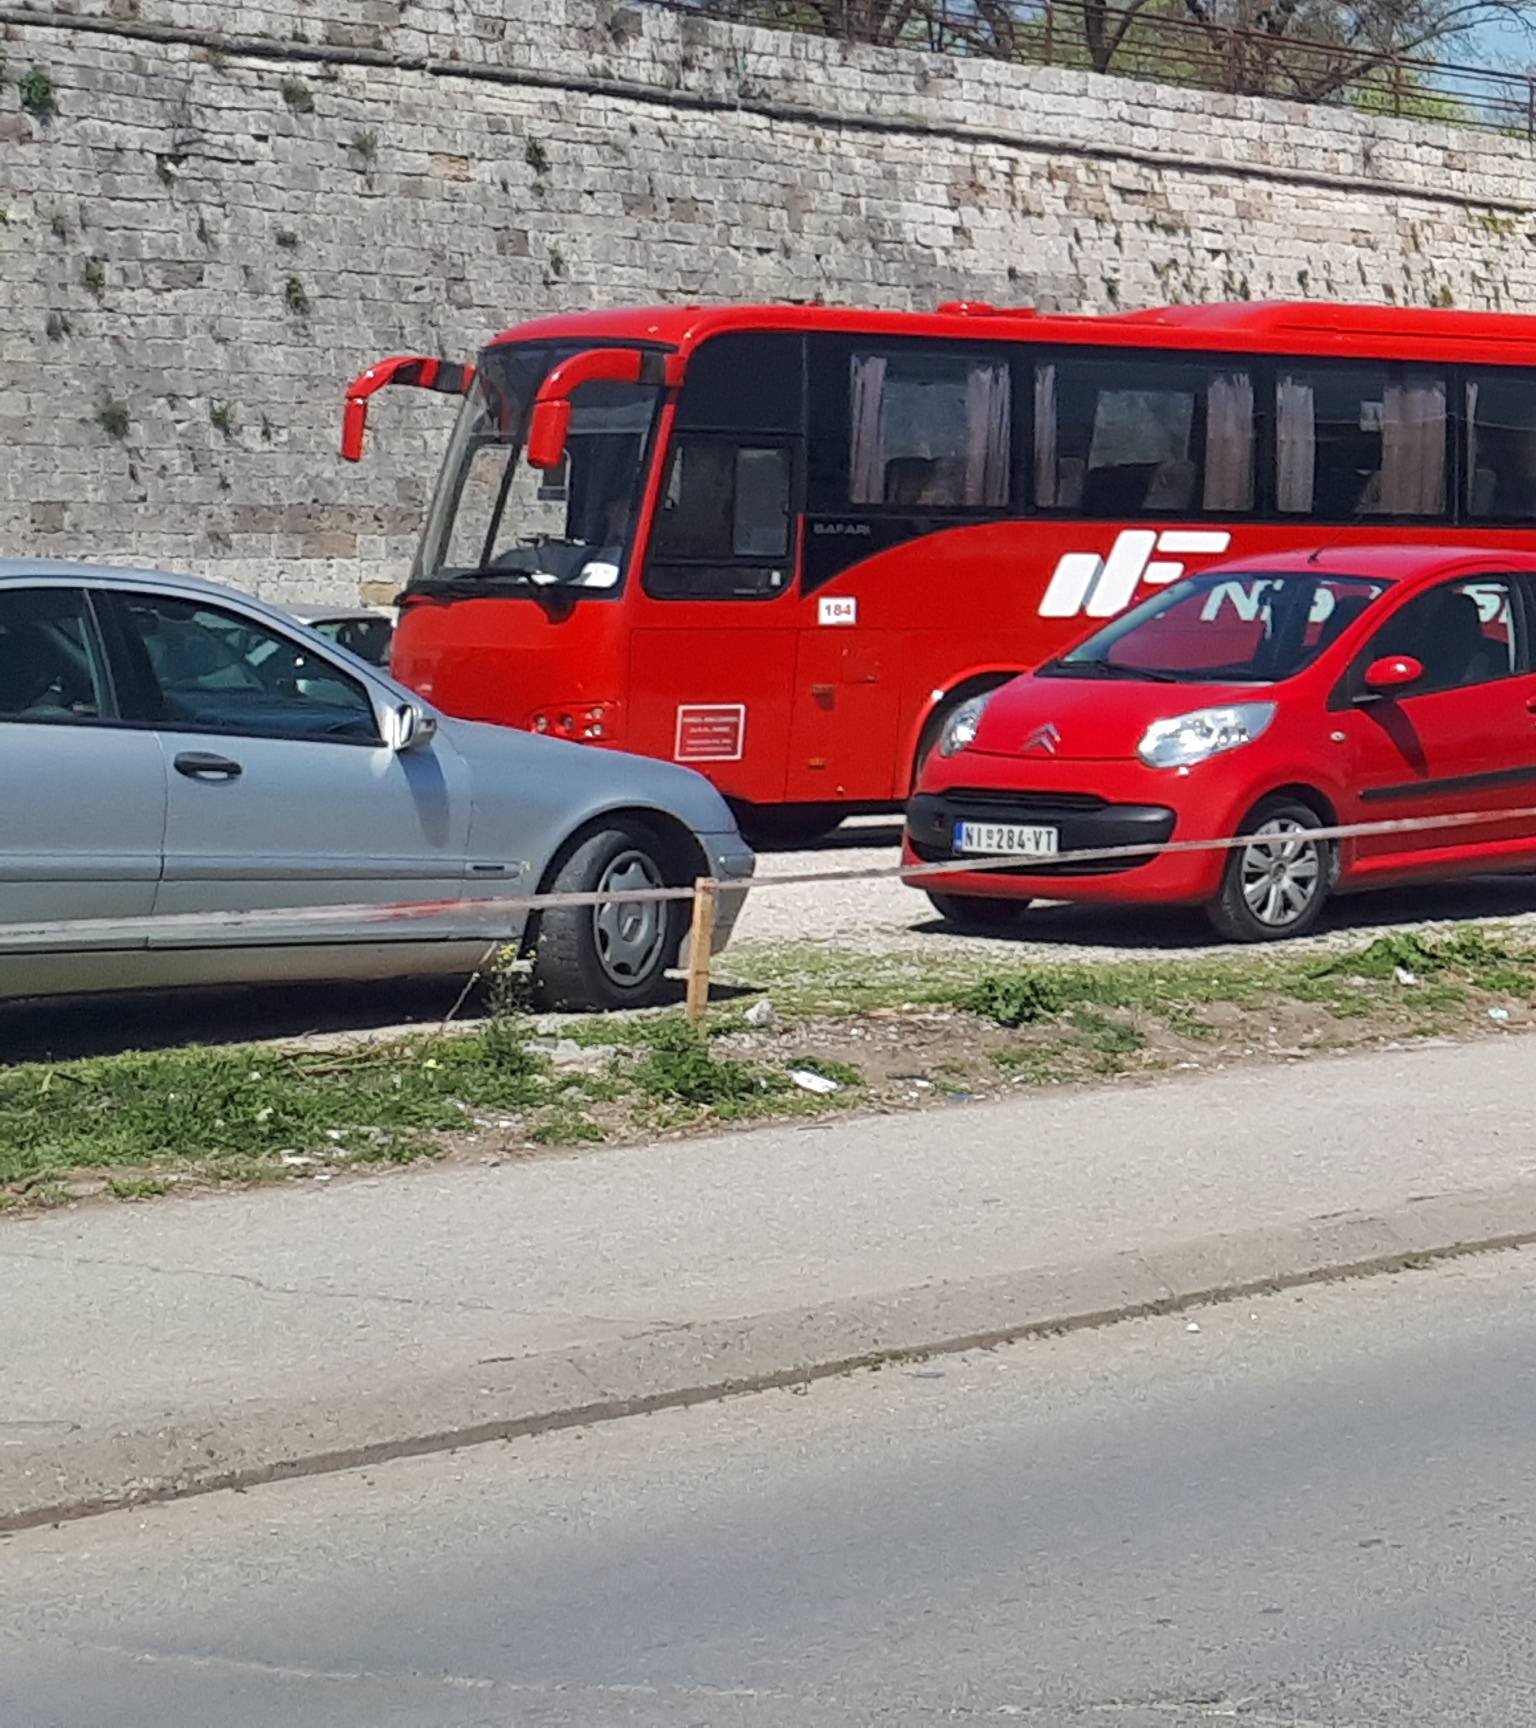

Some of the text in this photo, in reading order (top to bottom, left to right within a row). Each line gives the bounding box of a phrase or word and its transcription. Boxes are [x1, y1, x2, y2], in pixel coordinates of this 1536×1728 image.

[824, 603, 852, 617] 184
[964, 826, 1054, 852] NI 284-VT
